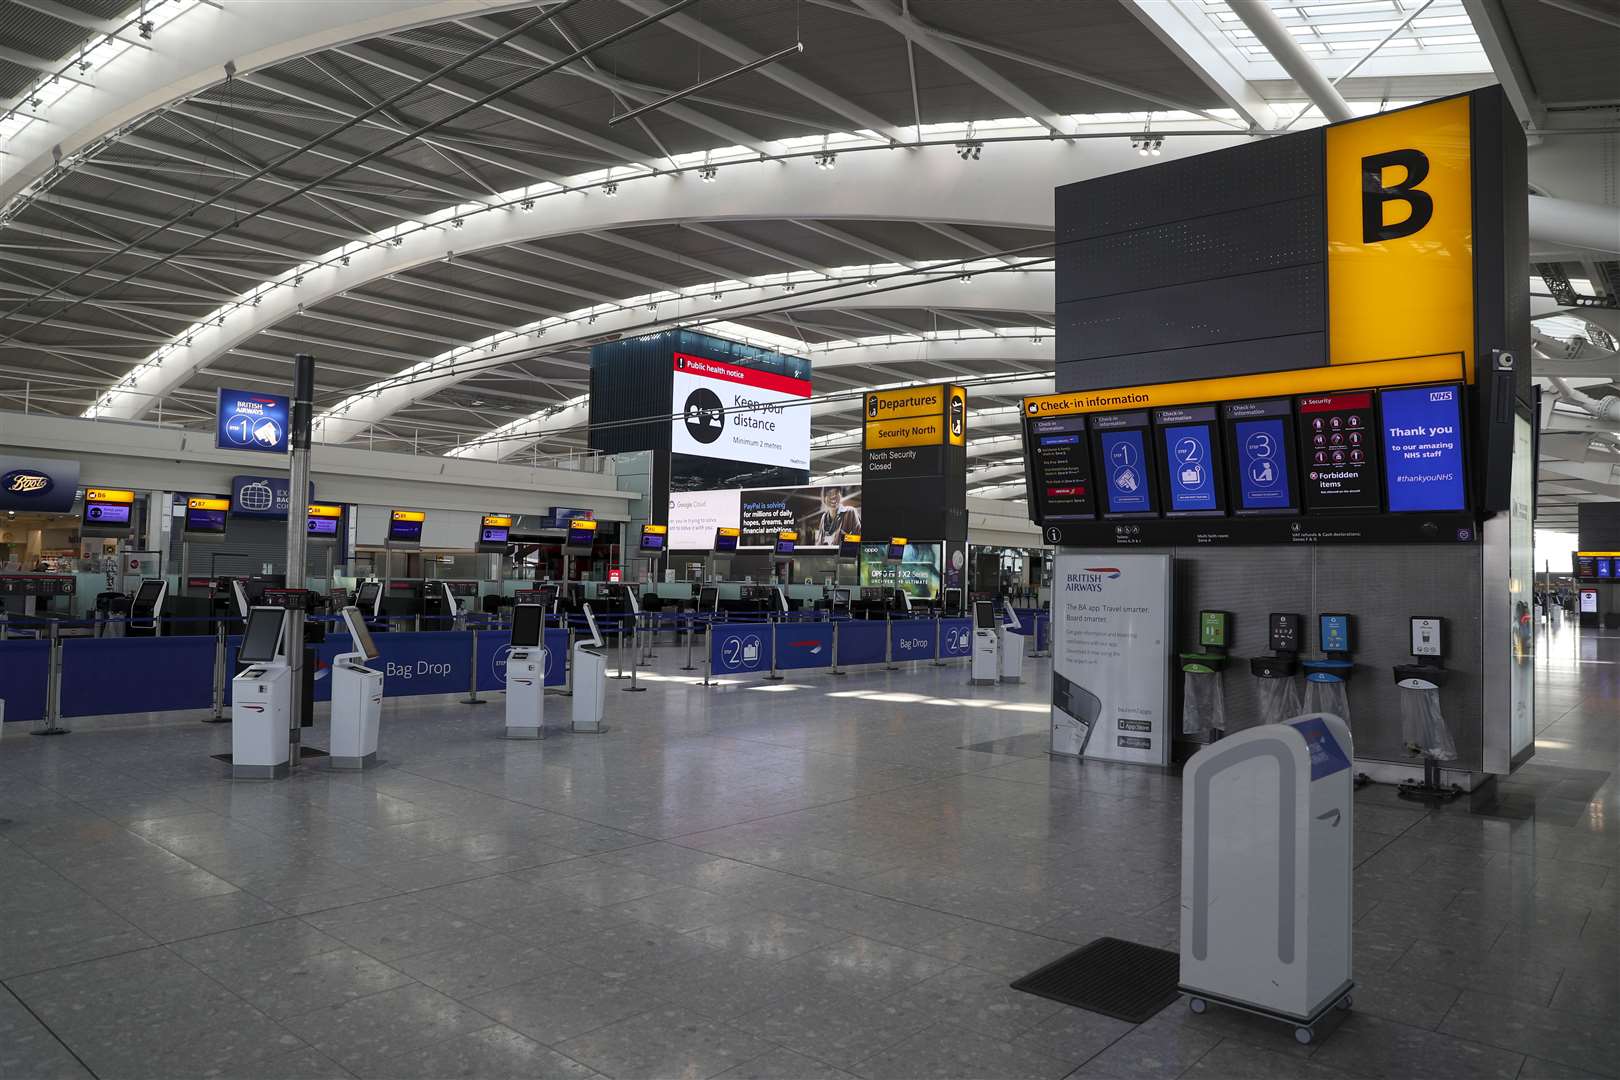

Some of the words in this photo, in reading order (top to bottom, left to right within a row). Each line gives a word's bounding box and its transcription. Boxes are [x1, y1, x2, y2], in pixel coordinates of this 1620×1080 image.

[1361, 149, 1433, 244] B
[687, 360, 706, 372] Public
[706, 363, 726, 376] health
[726, 368, 744, 379] notice
[1040, 399, 1084, 411] Check-in
[1086, 393, 1150, 407] information
[1431, 392, 1451, 400] NHS
[236, 401, 262, 410] BRITISH
[734, 395, 761, 414] Keep
[762, 402, 784, 416] your
[879, 396, 936, 411] Departures
[236, 408, 264, 416] AIRWAYS
[734, 414, 776, 432] distance
[240, 420, 246, 441] 1
[878, 428, 910, 438] Security
[912, 425, 936, 436] North
[1390, 426, 1426, 437] Thank
[1429, 426, 1453, 437] you
[733, 436, 759, 447] Minimum
[764, 442, 782, 450] metres
[1256, 435, 1271, 457] 3
[1418, 442, 1454, 450] amazing
[870, 452, 888, 460] North
[889, 450, 916, 459] Security
[1122, 445, 1128, 464] 1
[1184, 440, 1198, 461] 2
[1422, 450, 1442, 458] staff
[870, 462, 892, 470] Closed
[1320, 472, 1358, 480] Forbidden
[1397, 474, 1453, 483] #thankyouNHS
[8, 474, 48, 492] Boots
[677, 502, 692, 510] Google
[766, 502, 786, 510] solving
[780, 510, 792, 518] daily
[1067, 574, 1101, 582] BRITISH
[1066, 584, 1102, 592] AIRWAYS
[900, 639, 911, 649] Bag
[912, 639, 928, 648] Drop
[951, 630, 957, 650] 2
[730, 639, 740, 663] 2
[387, 662, 412, 679] Bag
[417, 661, 452, 678] Drop
